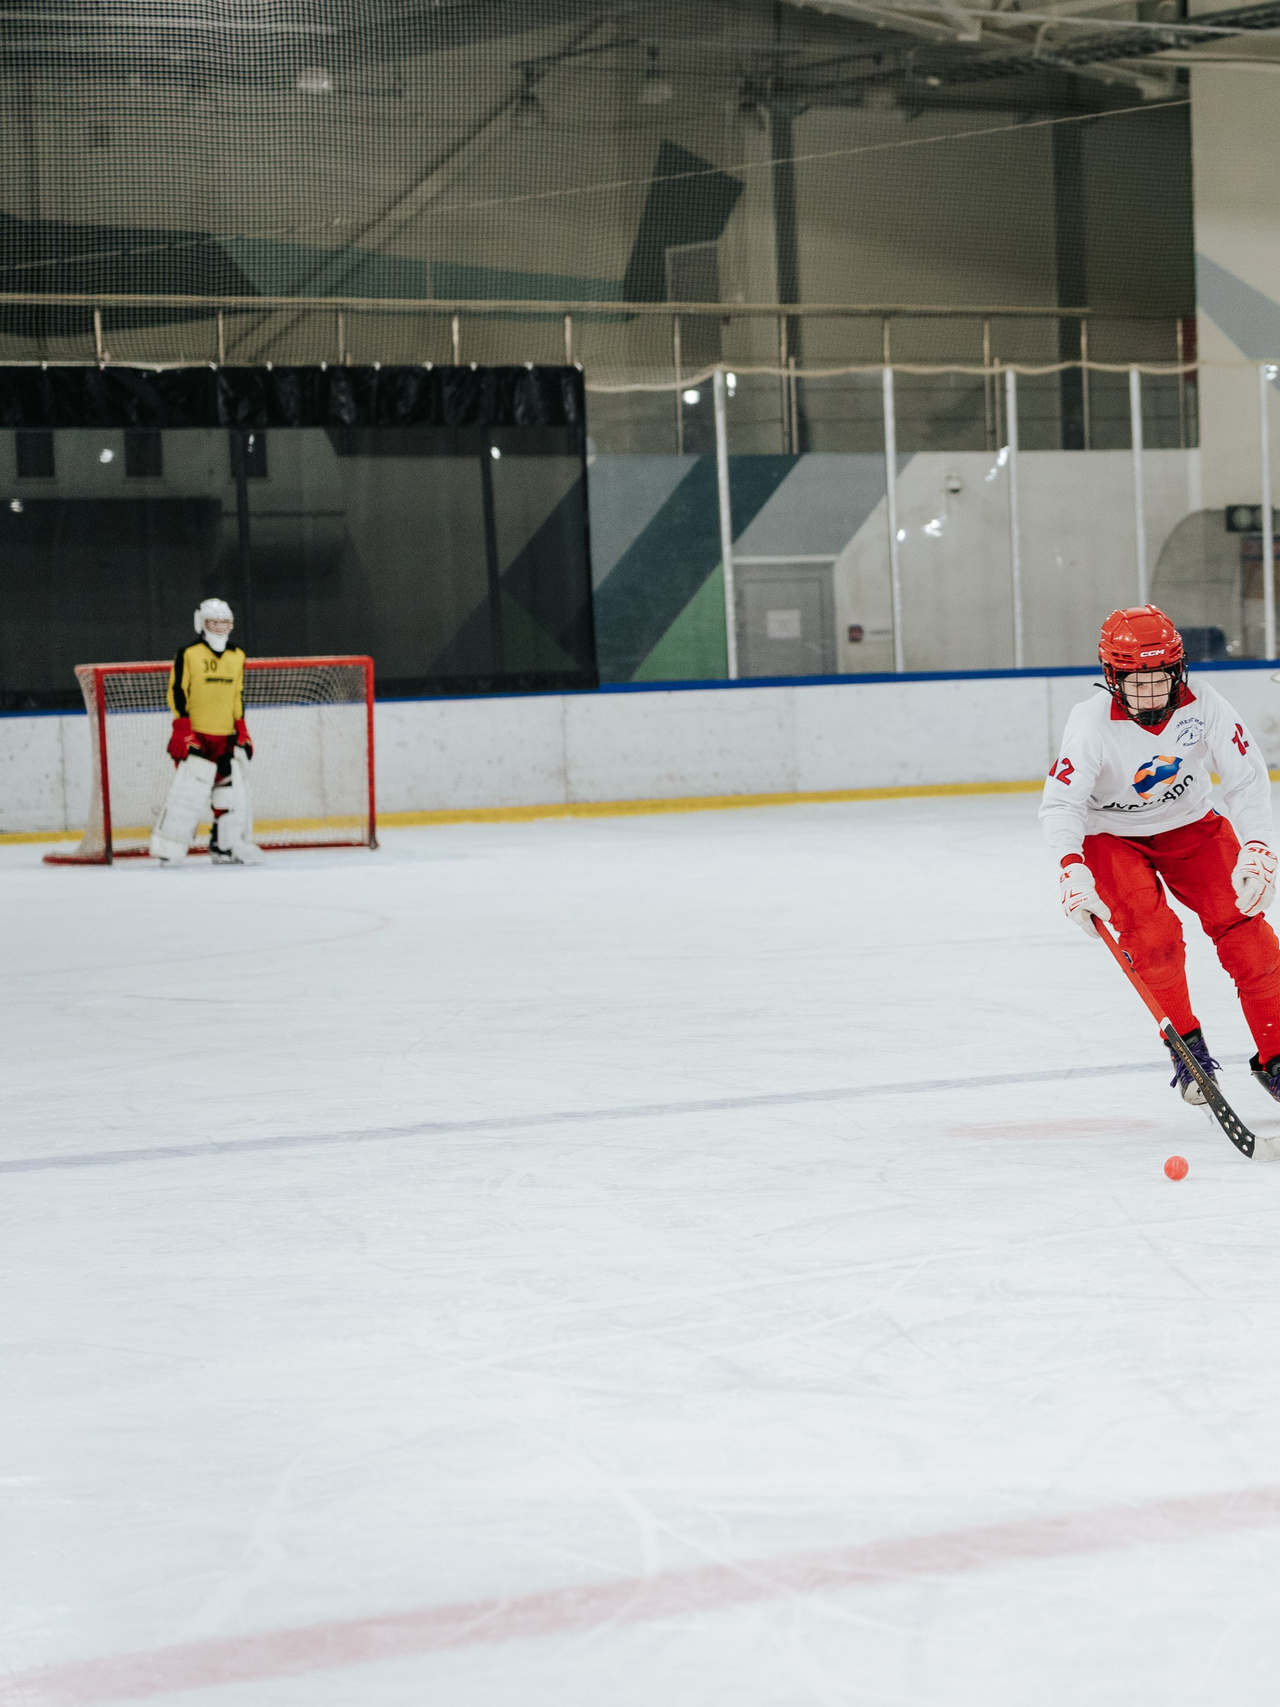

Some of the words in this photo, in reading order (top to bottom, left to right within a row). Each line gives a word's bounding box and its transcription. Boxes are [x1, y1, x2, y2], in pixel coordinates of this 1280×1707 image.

[1139, 648, 1165, 658] CCM
[1049, 757, 1075, 786] 12
[1247, 847, 1278, 861] STE
